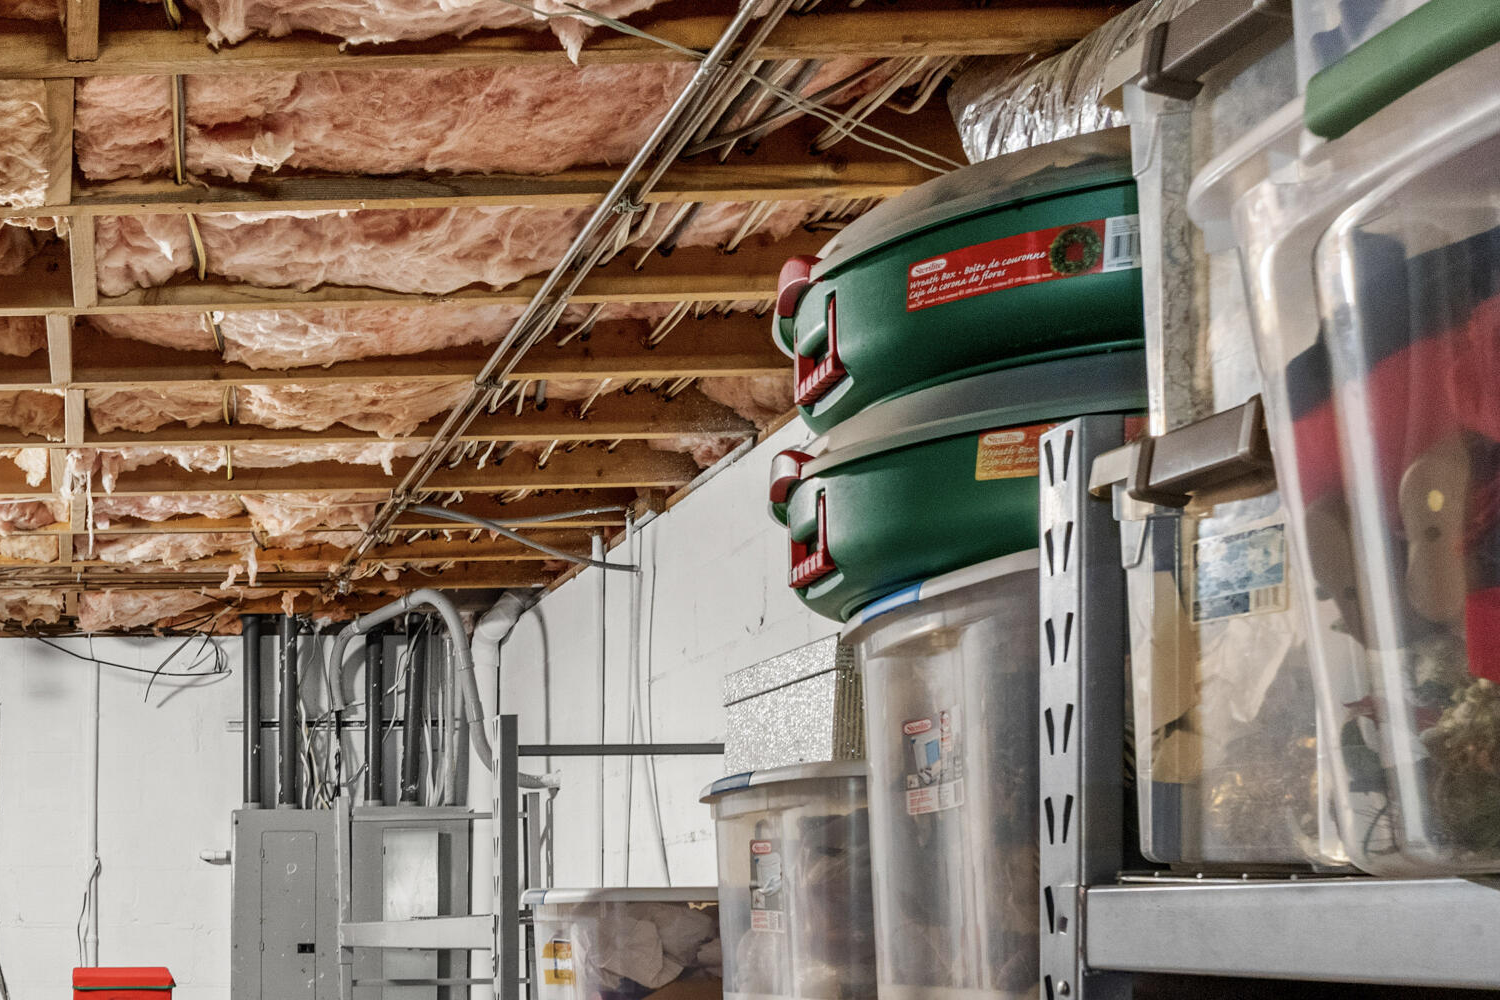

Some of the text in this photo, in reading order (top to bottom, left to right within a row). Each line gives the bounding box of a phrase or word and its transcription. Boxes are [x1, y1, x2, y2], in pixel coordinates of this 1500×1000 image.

[910, 274, 940, 289] Wreath
[941, 271, 956, 281] Box
[988, 258, 1000, 269] de
[1002, 251, 1046, 266] couronne
[913, 260, 946, 275] Sterilite
[909, 290, 926, 302] Caja
[927, 284, 938, 294] de
[939, 278, 967, 291] corona
[968, 273, 980, 284] de
[978, 268, 1007, 286] flores
